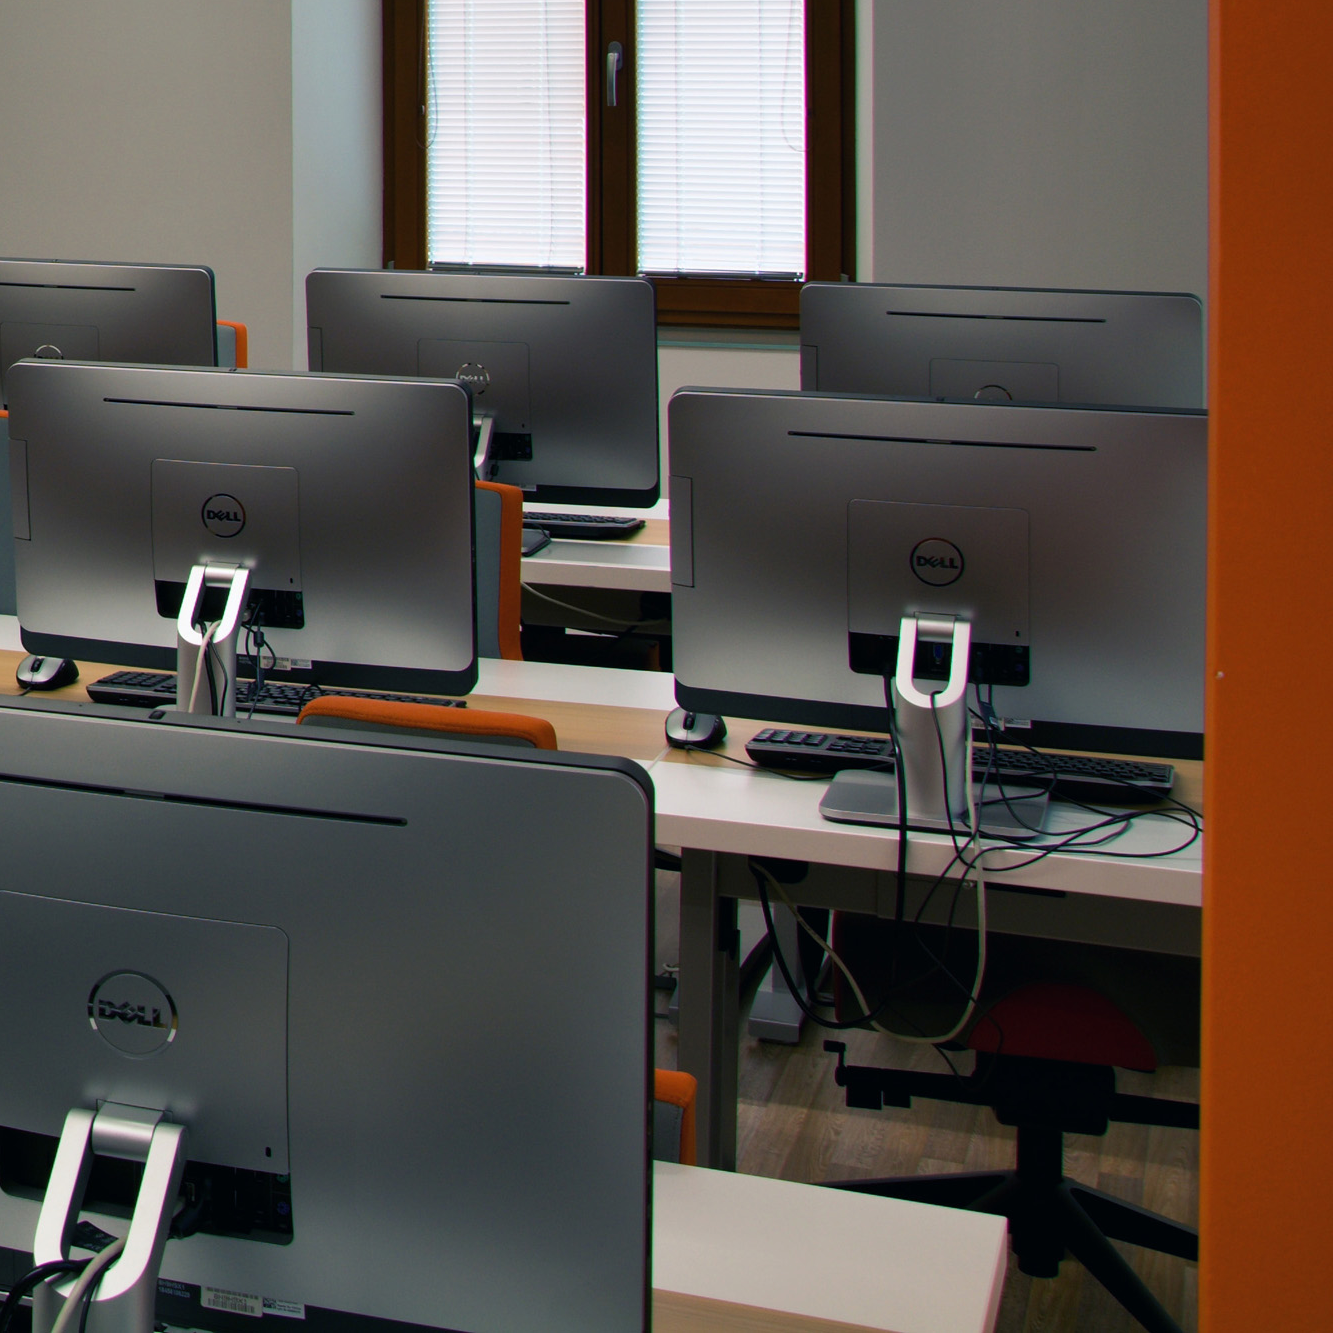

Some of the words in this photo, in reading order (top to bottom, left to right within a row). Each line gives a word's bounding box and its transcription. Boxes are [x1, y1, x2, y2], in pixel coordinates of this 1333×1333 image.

[206, 509, 242, 522] DELL
[915, 555, 959, 570] DELL
[98, 999, 168, 1029] DELL
